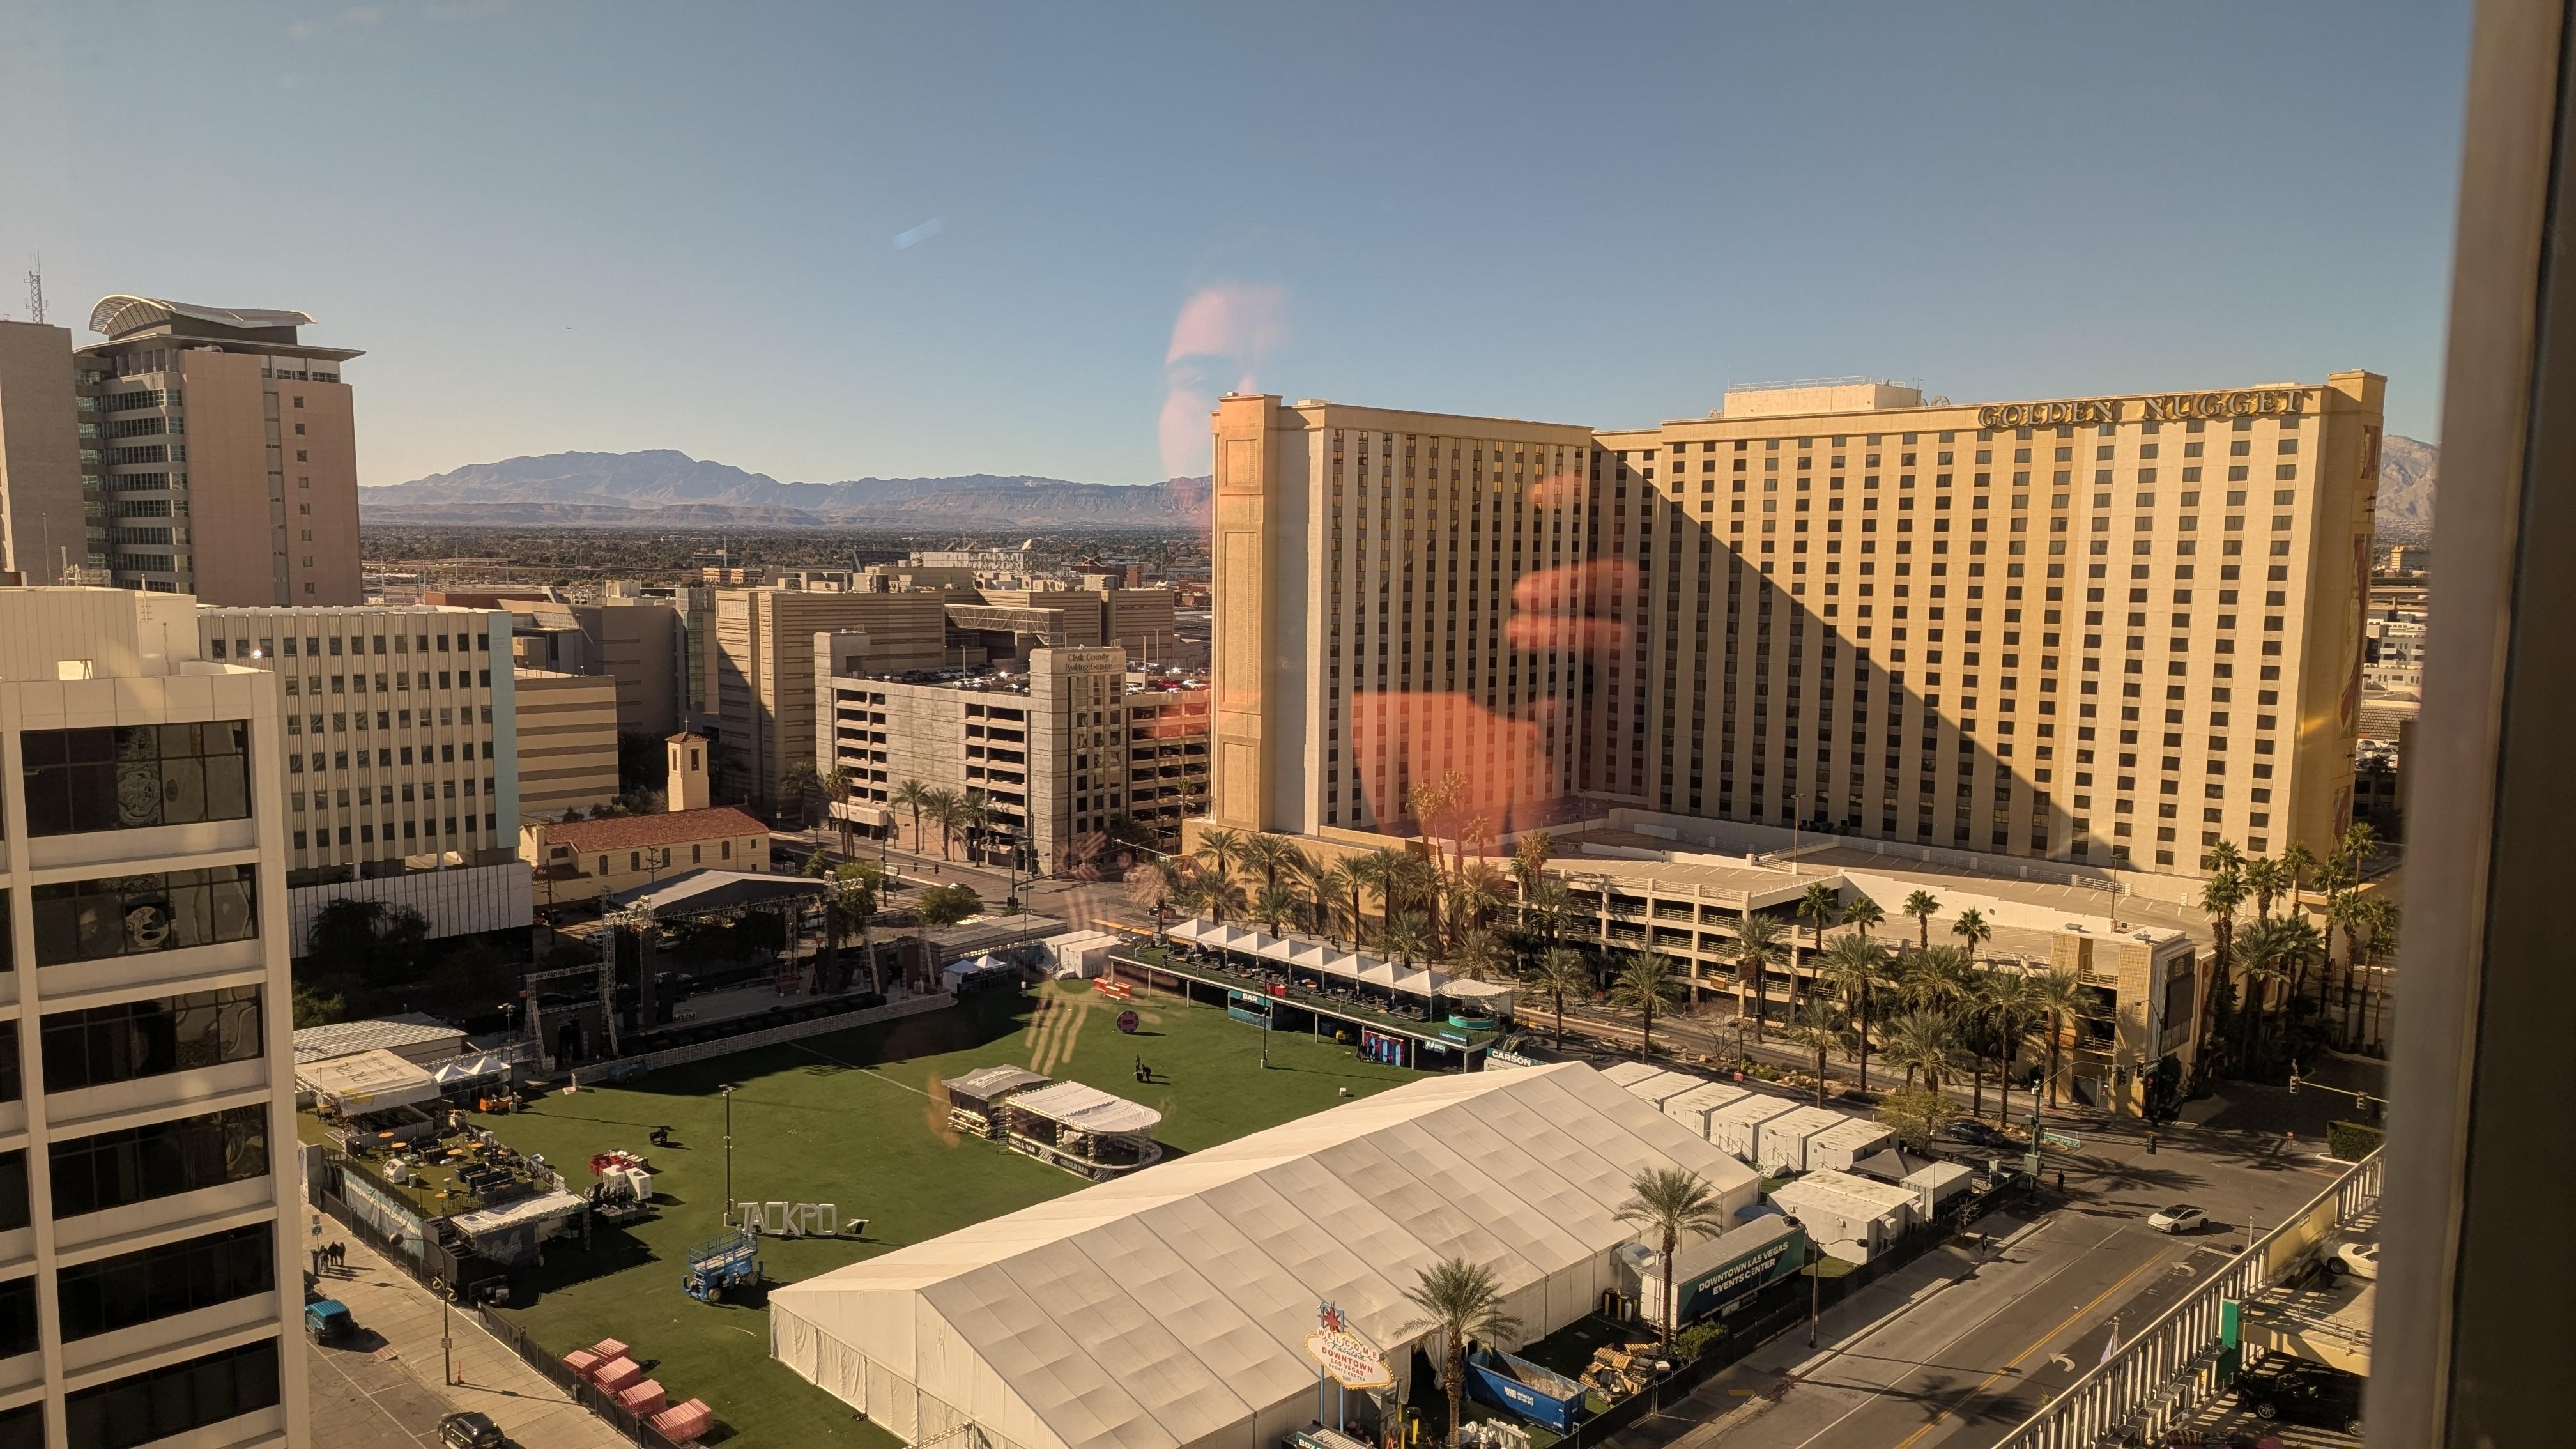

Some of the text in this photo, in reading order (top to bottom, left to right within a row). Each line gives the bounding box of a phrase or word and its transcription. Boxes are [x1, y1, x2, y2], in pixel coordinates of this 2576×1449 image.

[1979, 390, 2303, 427] GOLDEN NUGGET
[1068, 653, 1109, 662] Clark County
[1065, 663, 1113, 671] Parking Garage
[1243, 993, 1258, 1002] BAR
[1492, 1050, 1531, 1066] CARSON
[1008, 1137, 1024, 1149] CIRCLE
[1059, 1158, 1077, 1170] CIRCLE
[1698, 1242, 1788, 1292] DOWNTOWN LAS VEGAS
[1713, 1259, 1775, 1295] EVENTS CENTER
[1319, 1330, 1377, 1358] WELCOME
[1322, 1347, 1373, 1374] DOWNTOWN
[1331, 1358, 1363, 1376] LAS VEGAS
[1329, 1363, 1346, 1374] EVENTS
[1348, 1371, 1366, 1382] CENTER
[1299, 1438, 1315, 1449] BOX
